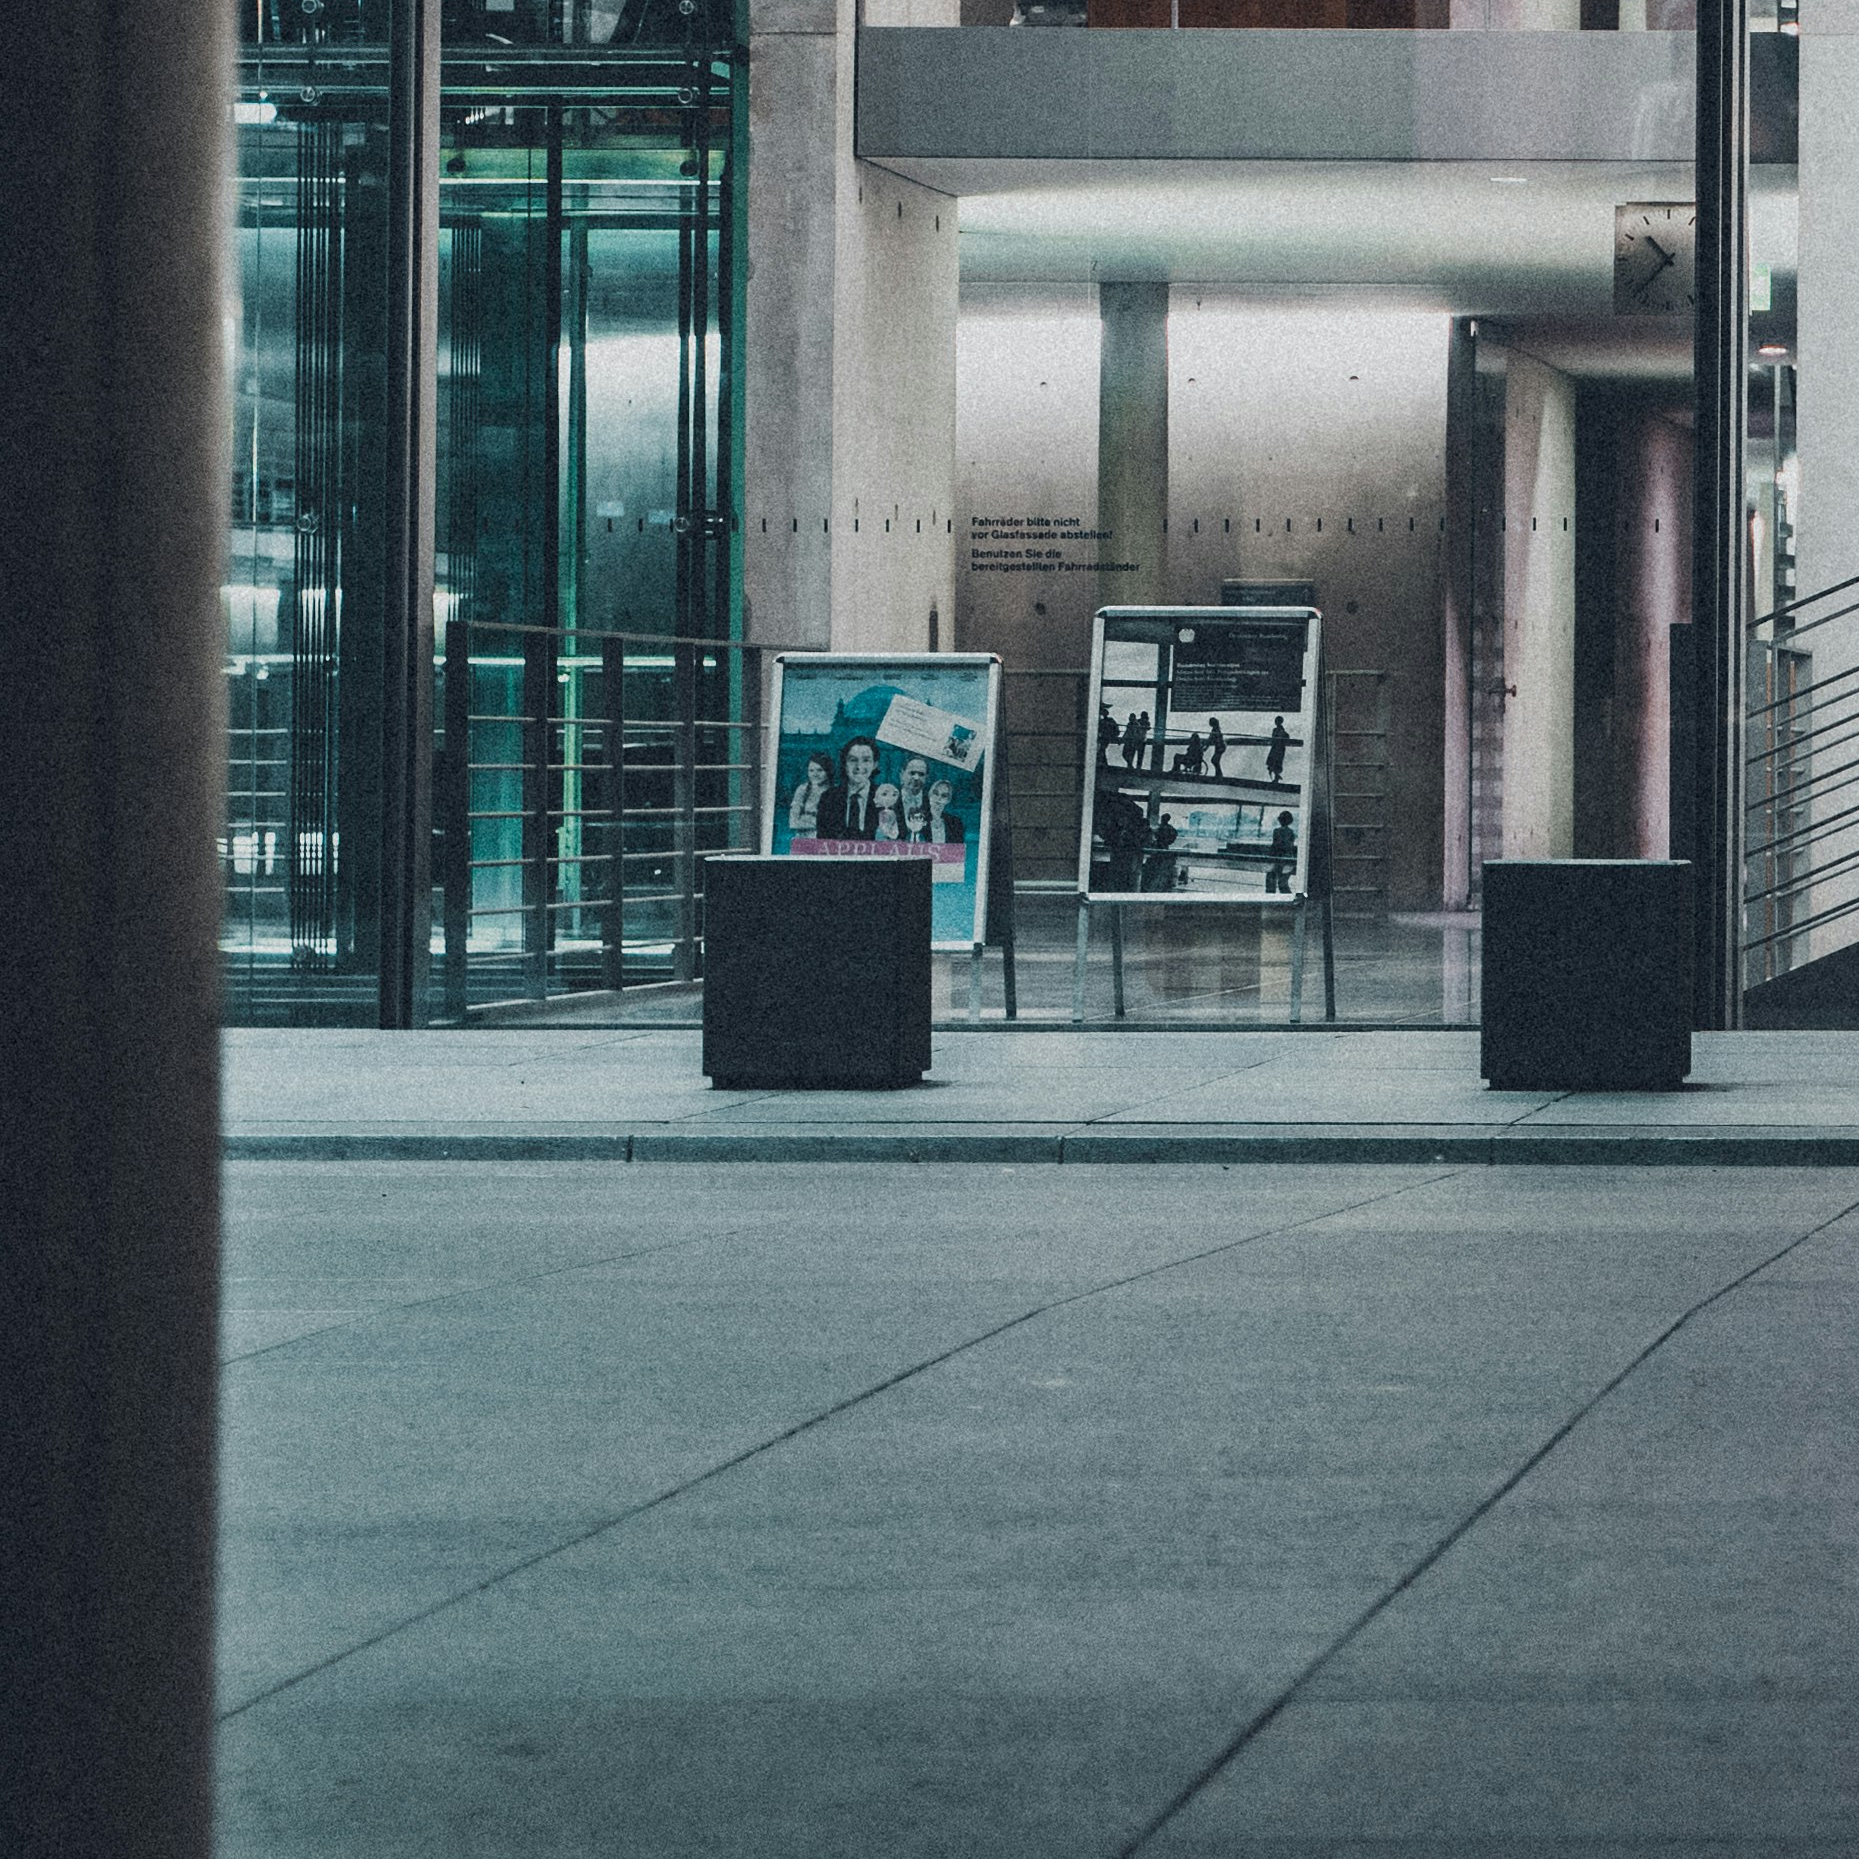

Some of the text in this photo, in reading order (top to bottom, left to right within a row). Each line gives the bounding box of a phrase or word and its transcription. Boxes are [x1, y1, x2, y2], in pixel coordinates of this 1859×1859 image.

[1027, 516, 1051, 527] bitte
[1053, 516, 1080, 527] nicht
[971, 529, 1113, 540] vor Glasfassade abstellen!
[971, 548, 1062, 559] Benutzen Sie die
[971, 561, 1140, 573] bereitgestellten Fahrradständer
